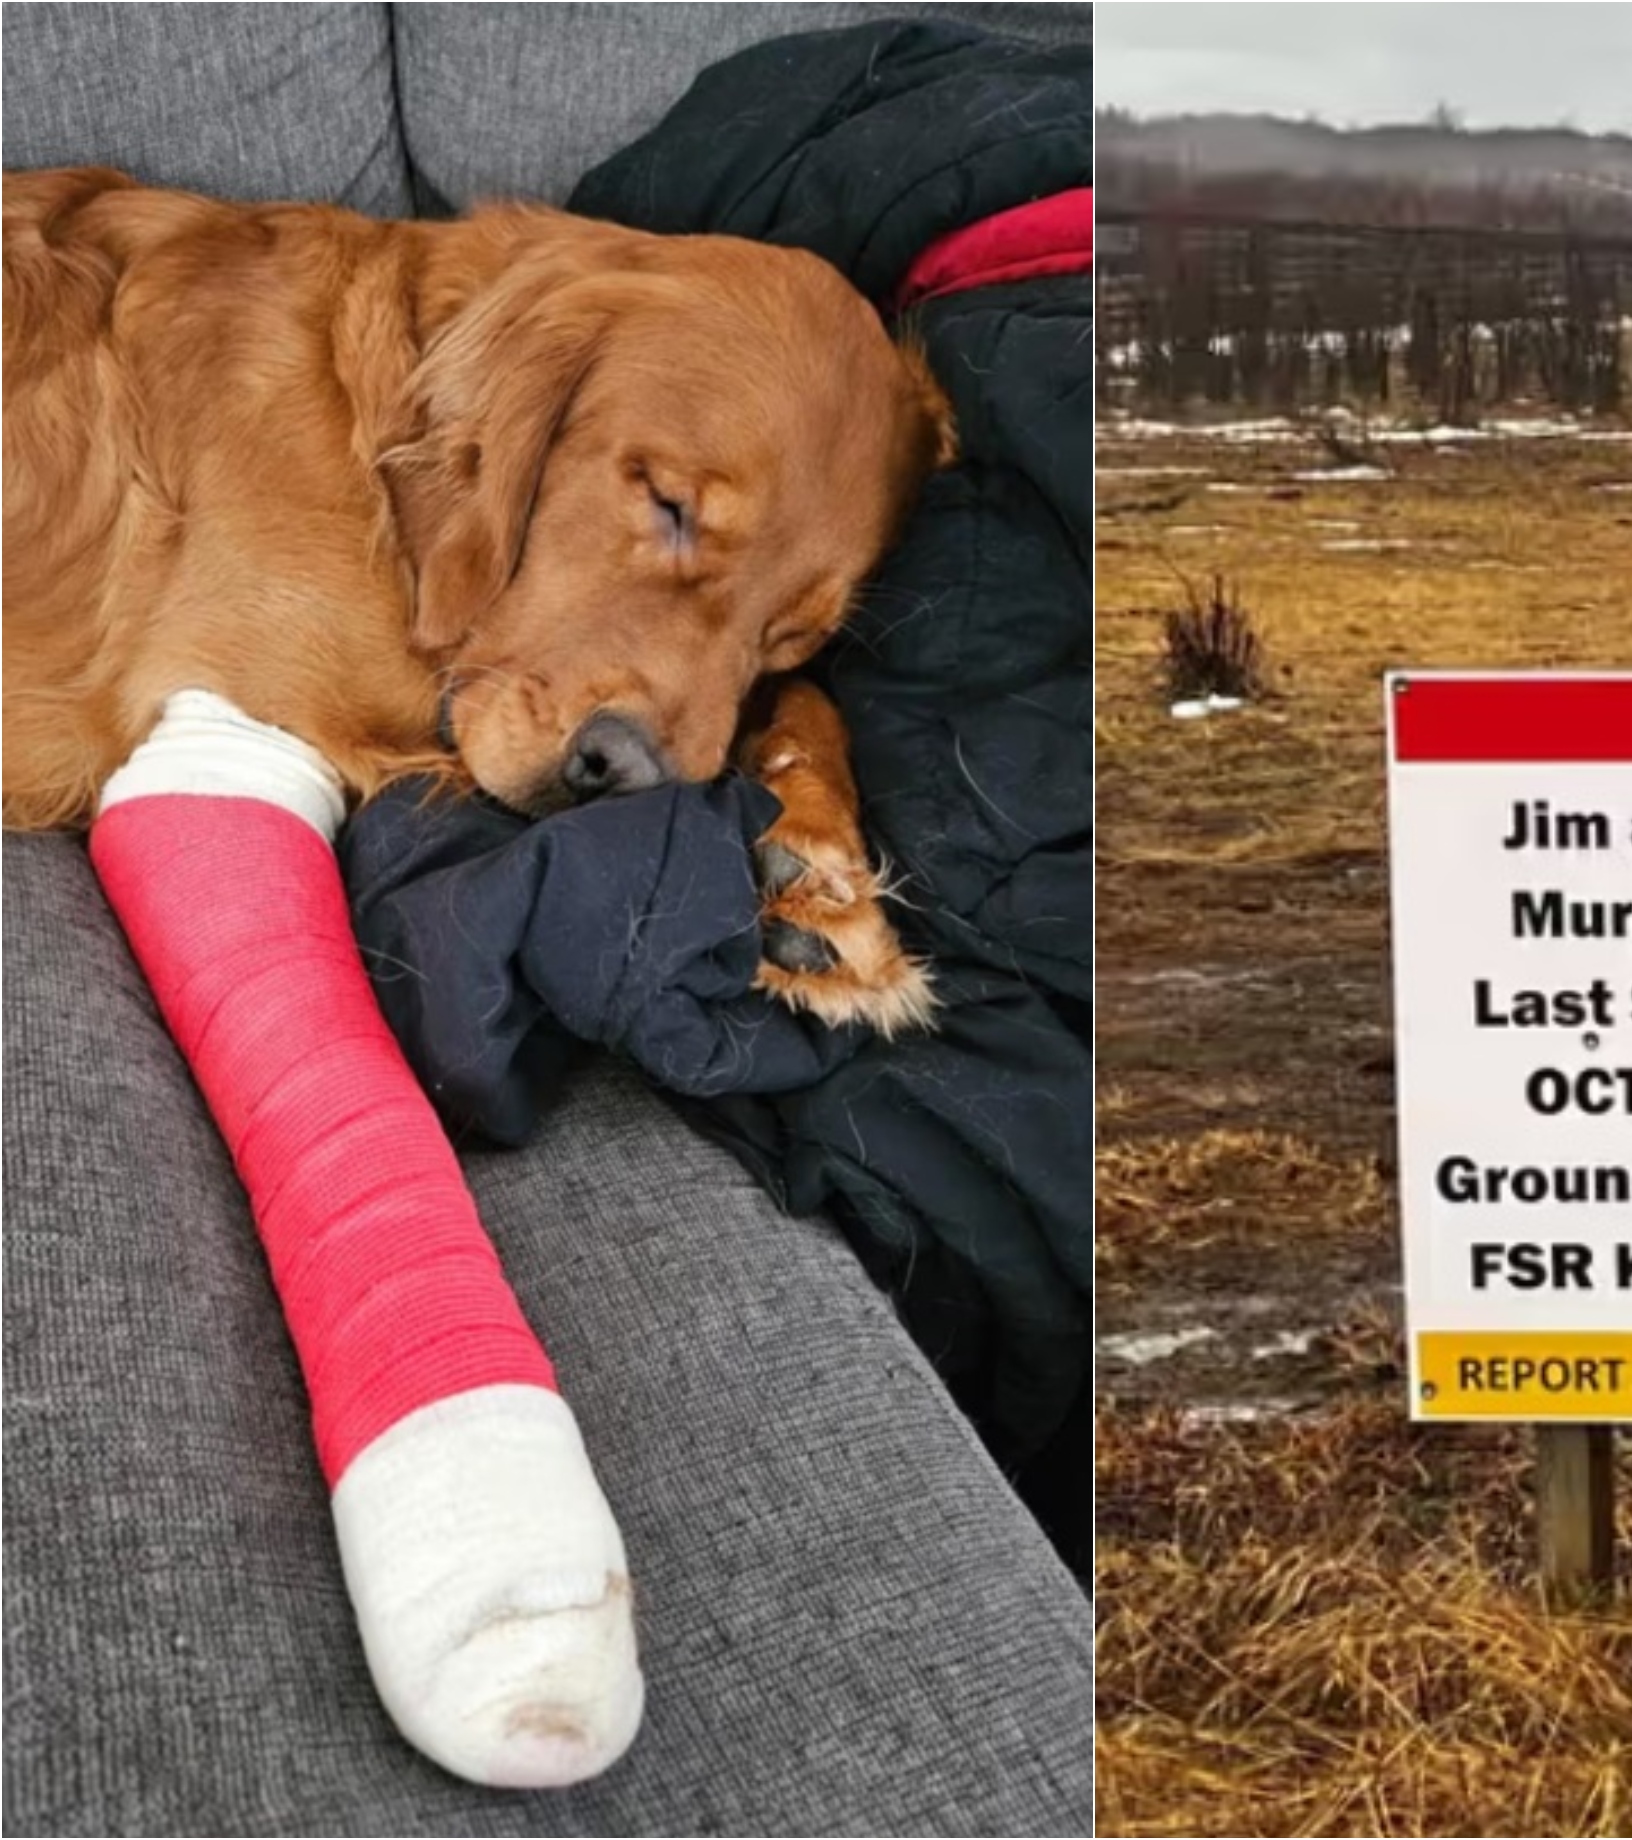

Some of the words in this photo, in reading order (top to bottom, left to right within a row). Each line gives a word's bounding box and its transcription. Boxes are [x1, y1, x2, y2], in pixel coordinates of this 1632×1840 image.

[1503, 800, 1610, 850] Jim
[1474, 979, 1614, 1027] Last
[1470, 1242, 1593, 1290] FSR
[1458, 1357, 1624, 1392] REPORT
